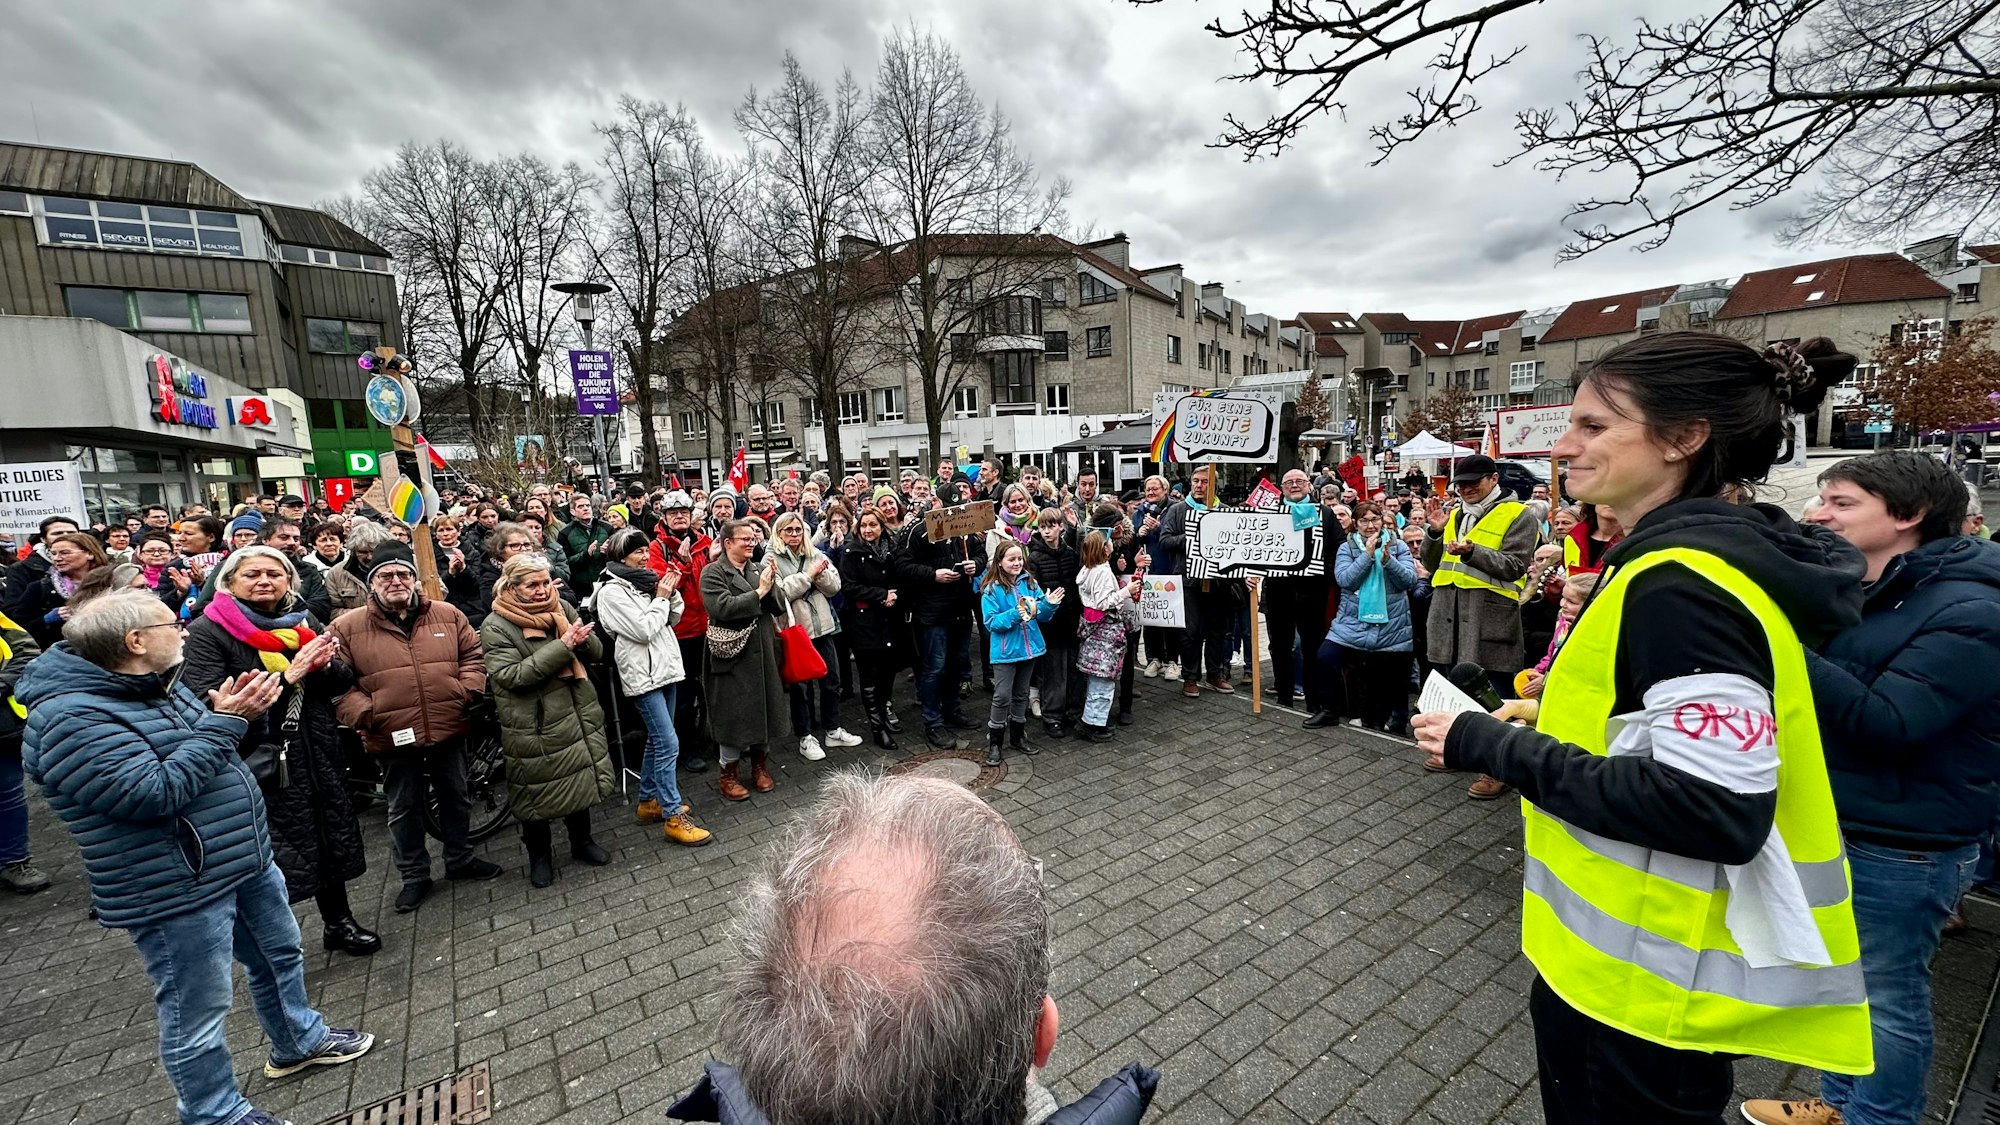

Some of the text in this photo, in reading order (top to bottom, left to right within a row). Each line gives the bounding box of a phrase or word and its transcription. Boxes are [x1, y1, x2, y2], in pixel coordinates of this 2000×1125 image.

[59, 232, 87, 240] FITNESS
[102, 233, 147, 242] seven
[153, 237, 196, 246] seven
[202, 243, 241, 251] HEALTHCARE
[579, 354, 604, 362] HOLEN
[577, 362, 608, 371] WIR UNS
[578, 378, 612, 387] ZUKUNFT
[581, 386, 612, 395] ZURÜCK
[1188, 399, 1252, 415] FÜR EINE
[1534, 411, 1565, 423] LILLI
[1185, 412, 1251, 433] BUNTE
[1183, 430, 1250, 448] ZUKUNFT
[13, 469, 65, 484] OLDIES
[15, 505, 72, 517] Klimaschutz
[1236, 516, 1269, 530] NIE
[1300, 516, 1315, 525] CDU
[1218, 531, 1285, 546] WIEDER
[1204, 545, 1300, 562] IST JETZT!
